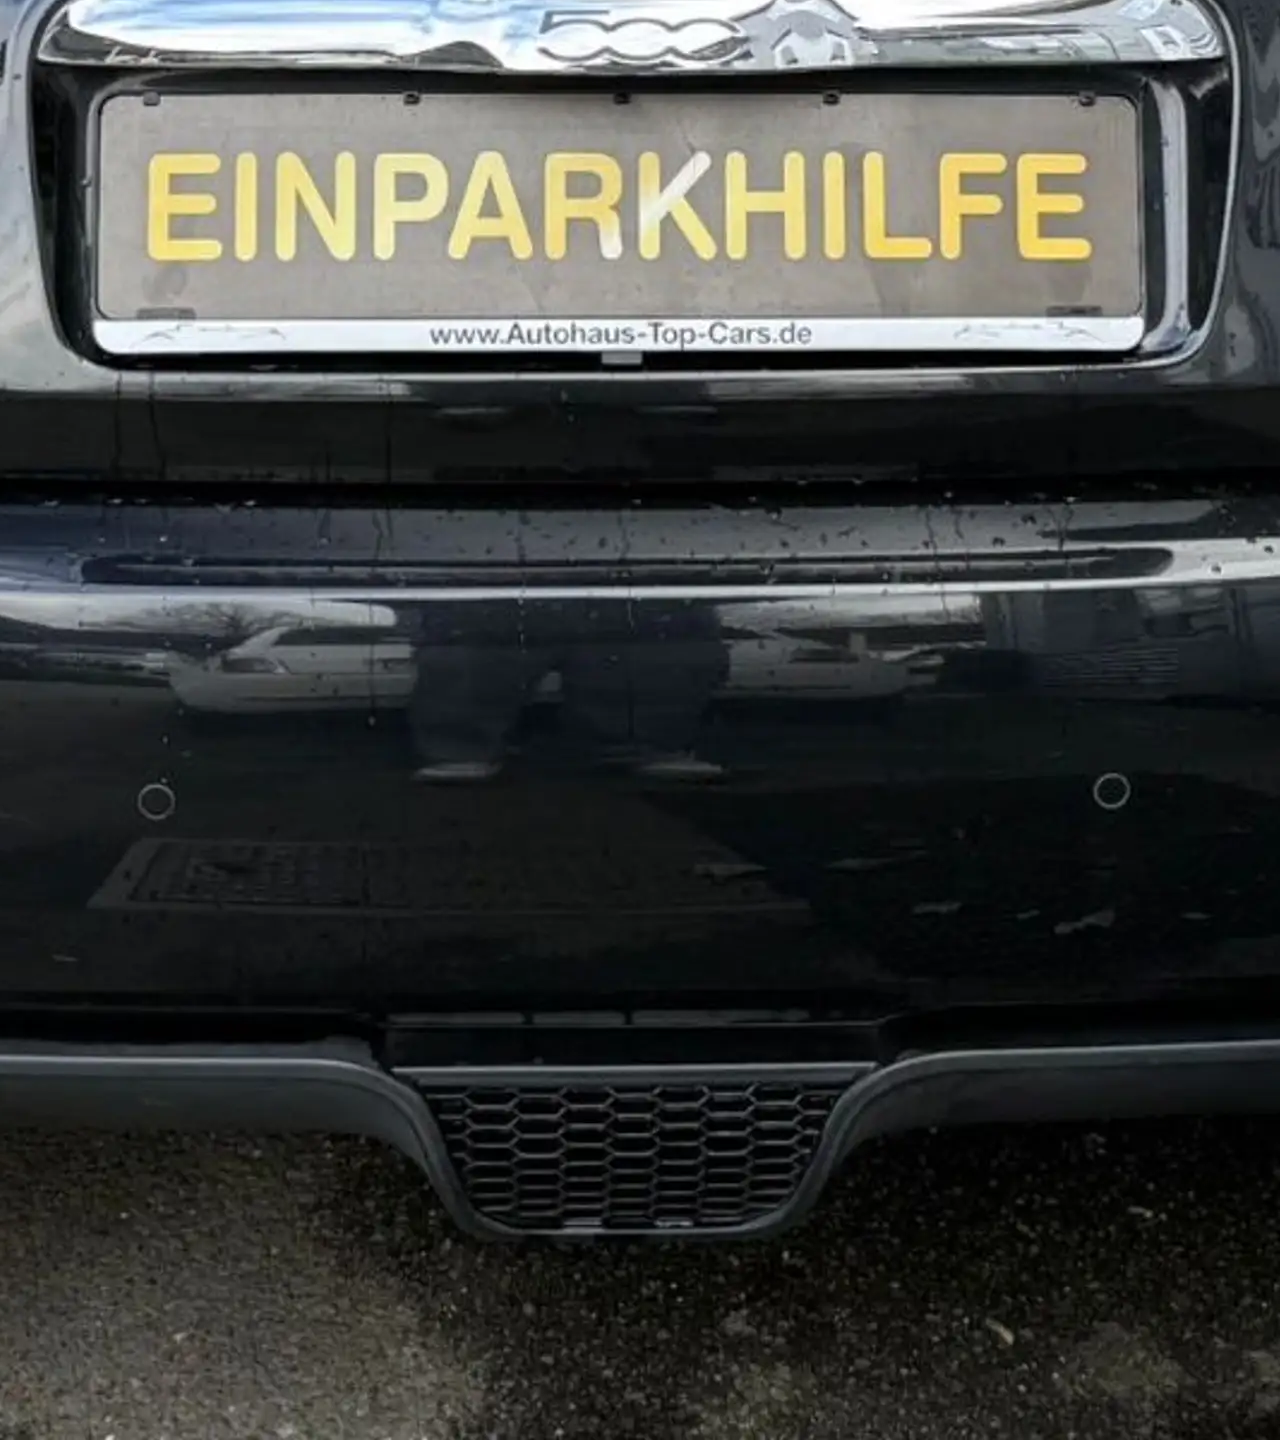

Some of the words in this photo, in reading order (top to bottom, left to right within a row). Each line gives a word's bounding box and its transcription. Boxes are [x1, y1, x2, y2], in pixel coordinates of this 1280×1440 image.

[536, 9, 746, 63] 500
[147, 151, 1092, 260] EINPARKHILFE
[429, 321, 813, 350] www.Autohaus-Top-Cars.de
